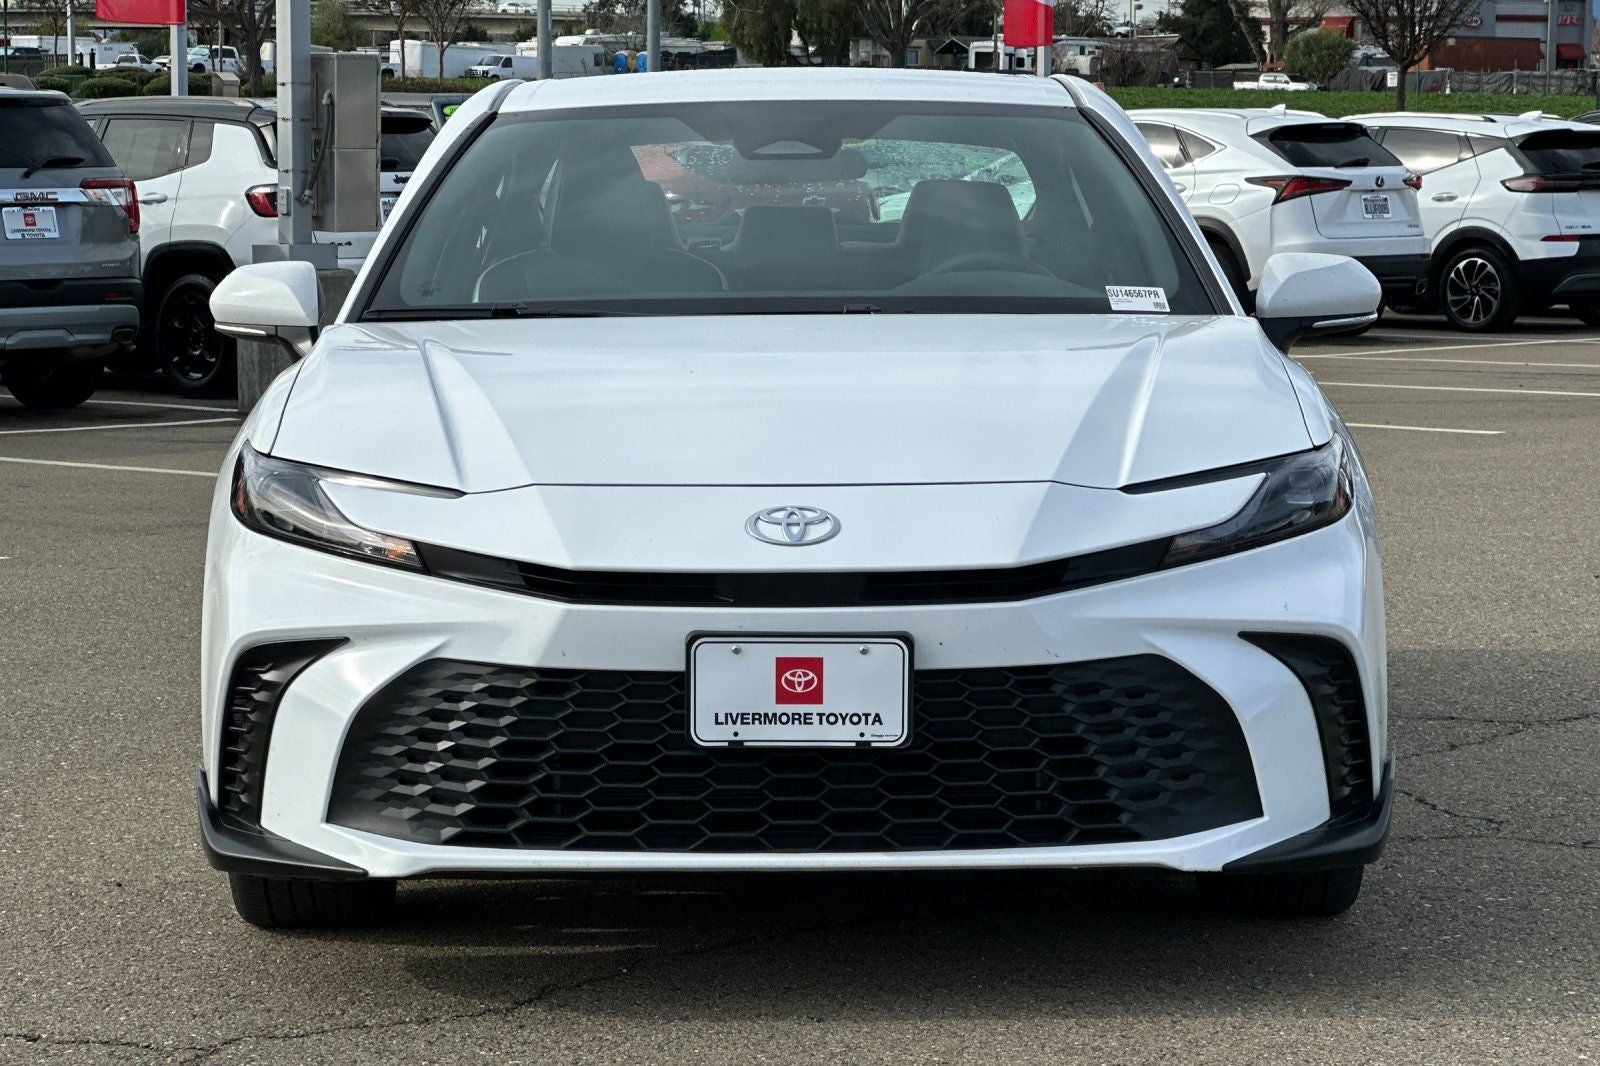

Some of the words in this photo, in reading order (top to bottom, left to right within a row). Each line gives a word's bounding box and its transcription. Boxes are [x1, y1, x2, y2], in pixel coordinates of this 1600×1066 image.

[14, 192, 58, 202] GMC
[1107, 288, 1160, 299] SU146567PR
[714, 712, 814, 726] LIVERMORE
[816, 712, 883, 726] TOYOTA
